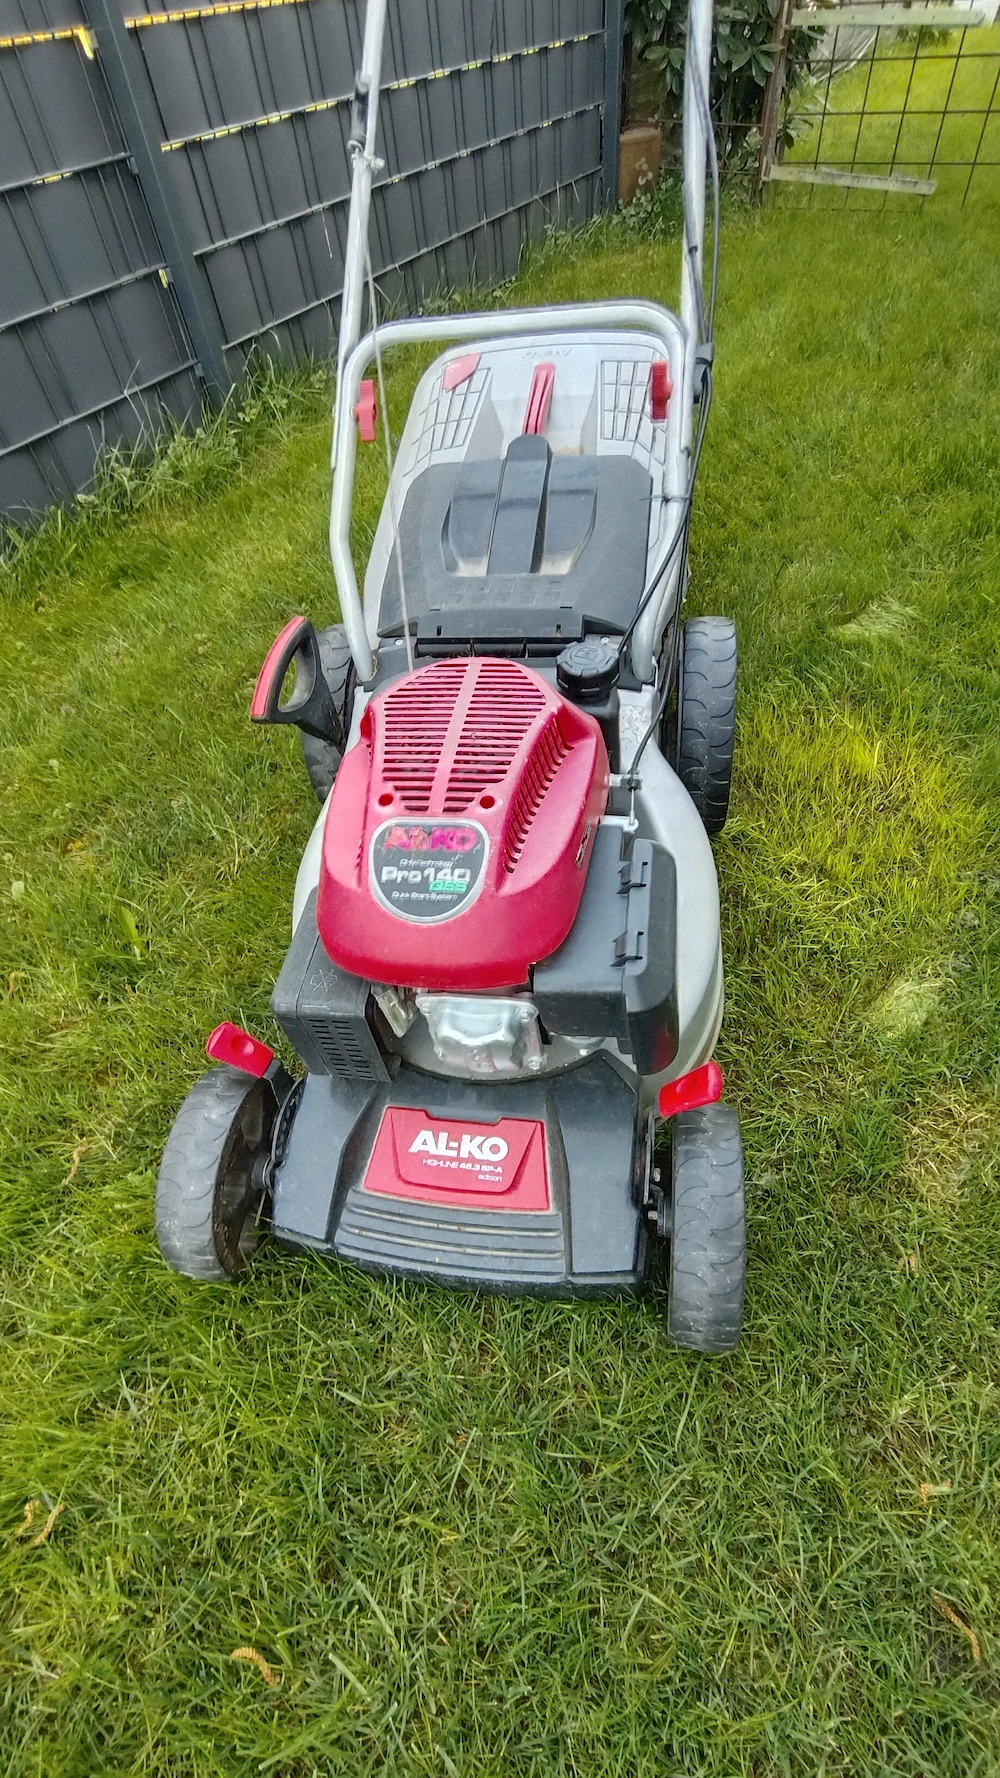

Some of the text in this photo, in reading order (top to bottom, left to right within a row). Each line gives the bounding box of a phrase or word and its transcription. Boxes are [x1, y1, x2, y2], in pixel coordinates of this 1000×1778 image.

[408, 1130, 509, 1162] AL-KO
[422, 1158, 458, 1169] HIGHLINE
[478, 1174, 503, 1182] edition
